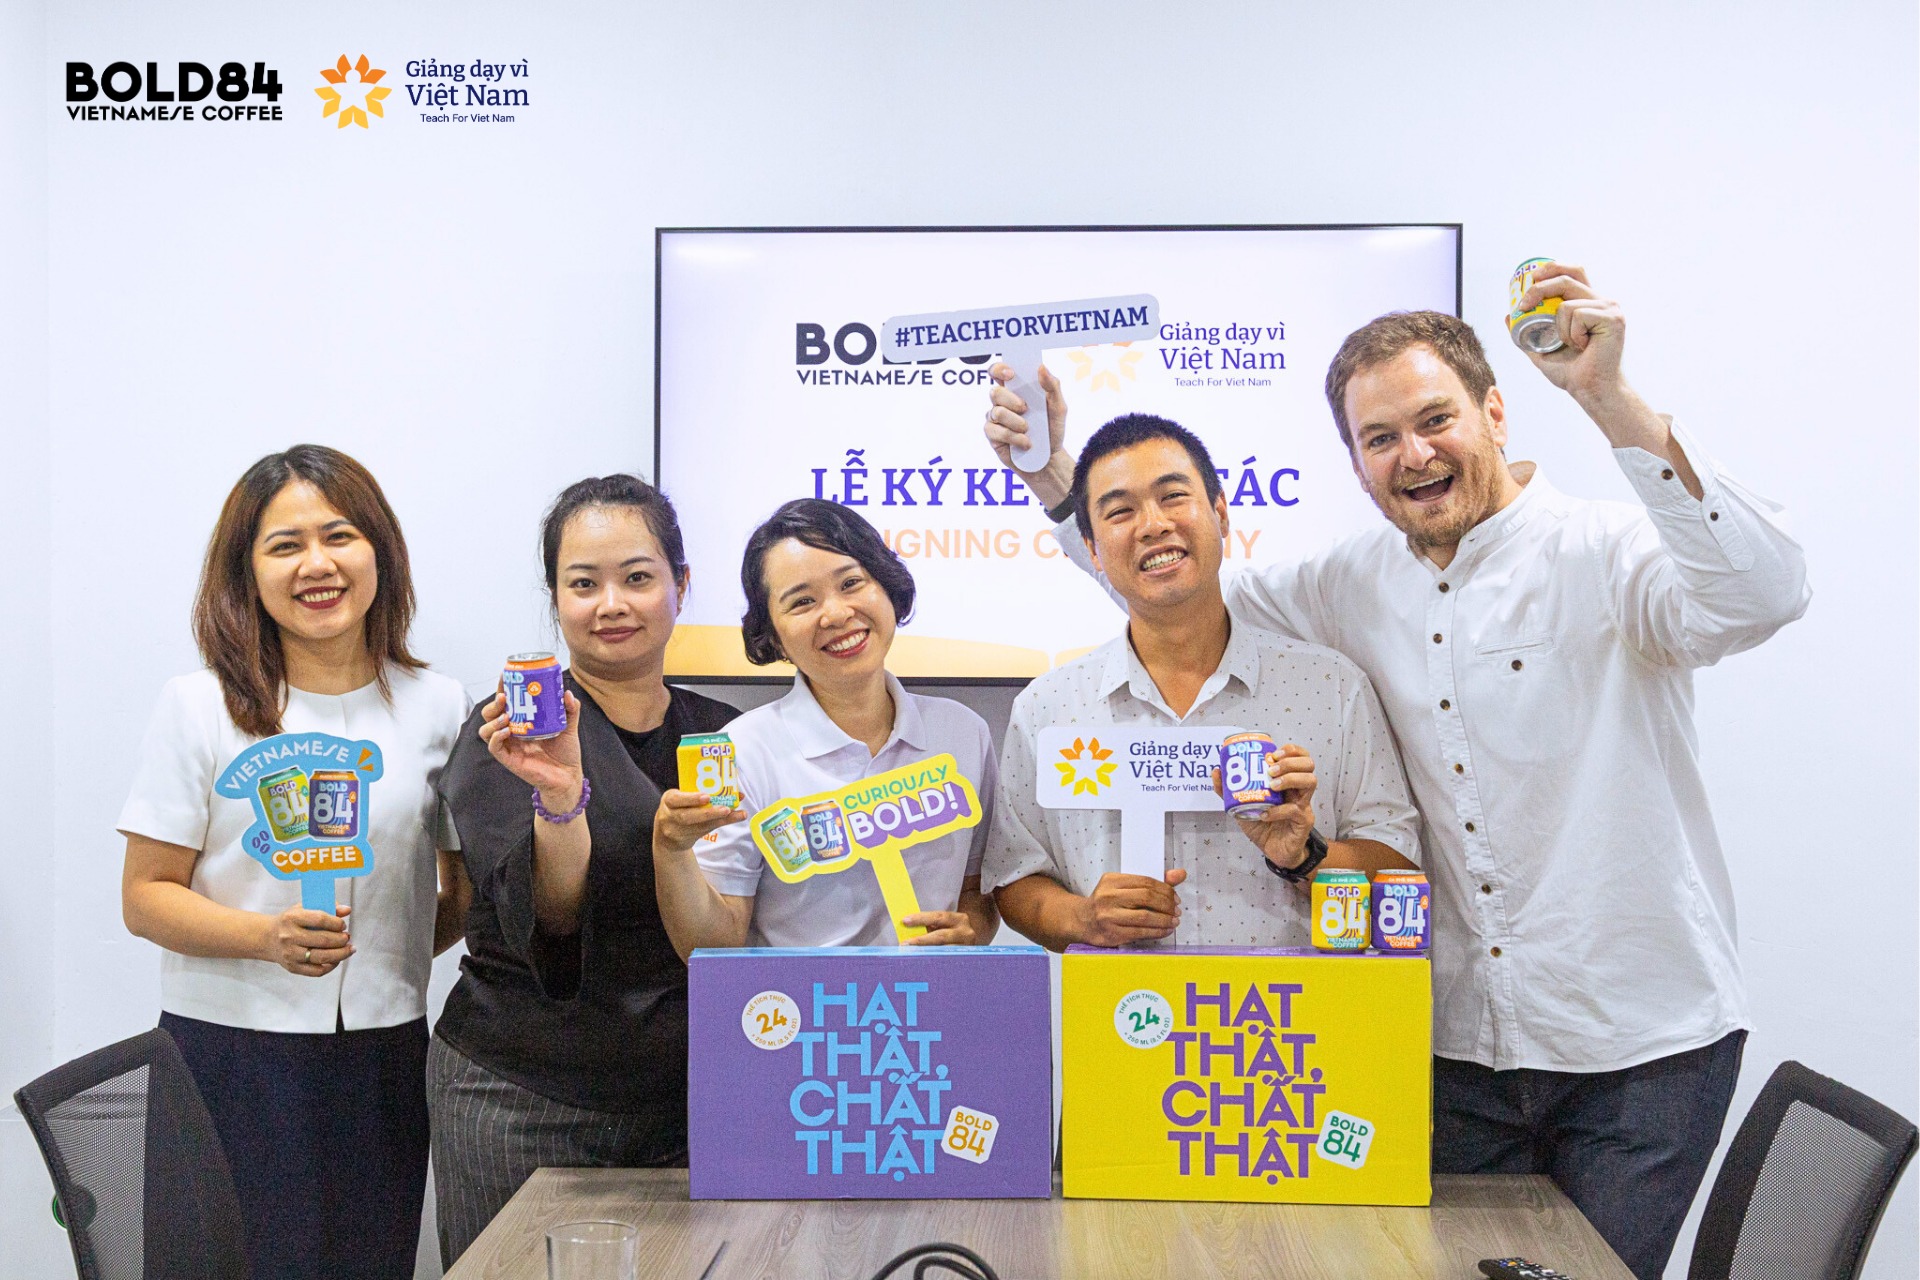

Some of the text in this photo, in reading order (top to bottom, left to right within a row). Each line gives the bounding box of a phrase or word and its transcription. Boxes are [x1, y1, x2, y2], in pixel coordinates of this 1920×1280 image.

[895, 306, 1149, 347] #TEACHFORVIETNAM
[1160, 321, 1285, 345] Giảng dạy vì
[1159, 346, 1286, 374] Việt Nam
[796, 369, 995, 386] VIETNAMESE COF
[1175, 377, 1272, 387] Teach For Viet Nam
[811, 448, 869, 506] LỄ
[881, 455, 952, 506] KÝ
[1215, 455, 1300, 507] ÁC
[884, 529, 1021, 559] IGNING
[701, 744, 732, 758] BOLD
[1129, 740, 1179, 759] Giảng
[1182, 741, 1212, 759] dạy
[1228, 741, 1263, 756] BOLD
[225, 740, 350, 791] VIETNAMESE
[1129, 760, 1173, 782] Việt
[268, 780, 297, 797] BOLD
[319, 781, 349, 792] BOLD
[843, 764, 948, 810] CURIOUSLY
[1141, 784, 1214, 792] Teach For Viet Na
[313, 792, 354, 824] 84
[808, 811, 833, 823] BOLD
[847, 782, 960, 842] BOLD!
[770, 819, 792, 837] BOLD
[808, 820, 843, 850] 84
[272, 846, 357, 867] COFFEE
[1327, 886, 1360, 898] BOLD
[1384, 884, 1419, 897] BOLD
[1320, 899, 1367, 936] 84
[1378, 897, 1426, 935] 84
[755, 1008, 788, 1034] 24
[813, 981, 929, 1034] HẠT
[1128, 1006, 1160, 1033] 24
[1185, 982, 1303, 1035] HẠT
[793, 1024, 949, 1083] THẬT,
[1166, 1026, 1323, 1084] THẬT,
[789, 1071, 952, 1126] CHẤT
[1161, 1075, 1327, 1128] CHẤT
[955, 1111, 993, 1131] BOLD
[1330, 1115, 1369, 1137] BOLD
[795, 1124, 944, 1182] THẬT
[948, 1124, 985, 1157] 84
[1323, 1129, 1361, 1163] 84
[1167, 1127, 1320, 1185] THẬT
